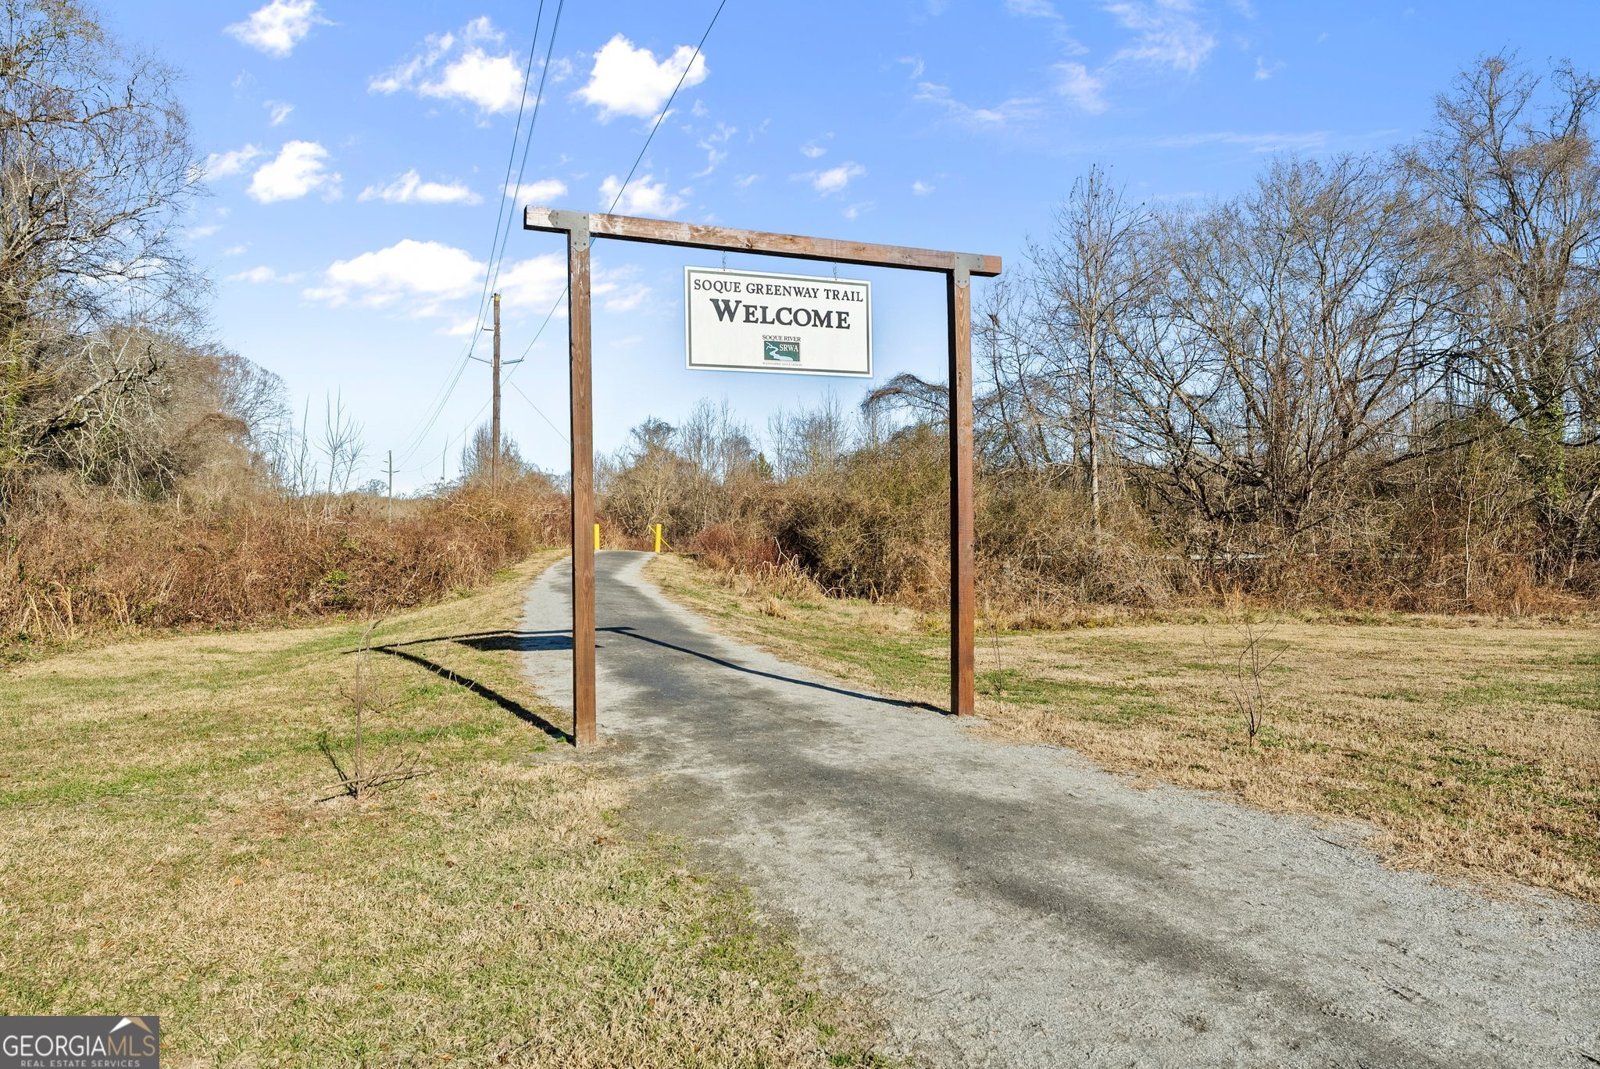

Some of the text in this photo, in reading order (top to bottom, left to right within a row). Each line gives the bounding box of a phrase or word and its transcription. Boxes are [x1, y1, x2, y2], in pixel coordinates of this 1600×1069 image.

[693, 279, 864, 302] SOQUE GREENWAY TRAIL
[709, 298, 851, 330] WELCOME
[779, 343, 799, 352] SRWA
